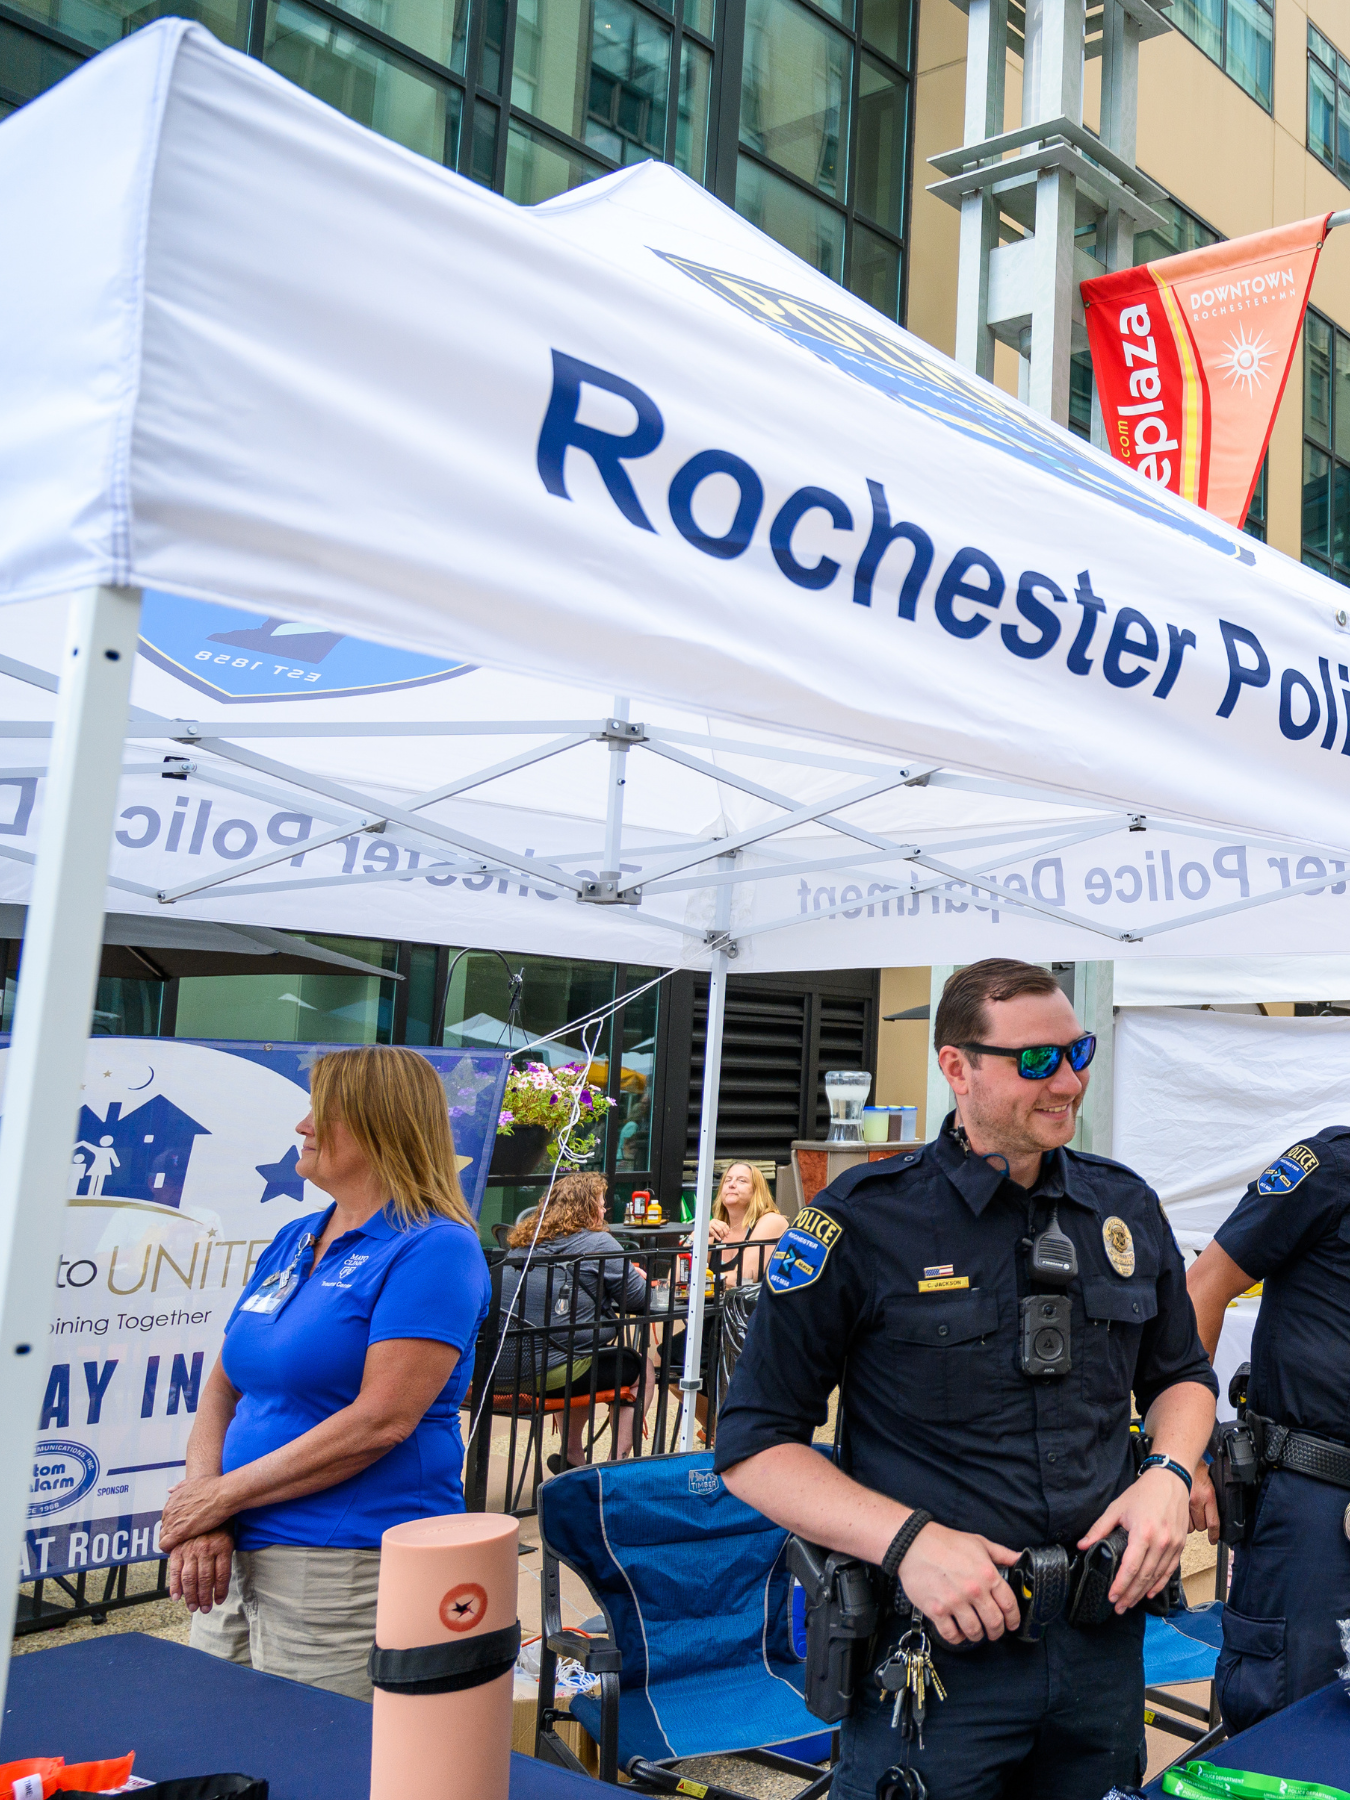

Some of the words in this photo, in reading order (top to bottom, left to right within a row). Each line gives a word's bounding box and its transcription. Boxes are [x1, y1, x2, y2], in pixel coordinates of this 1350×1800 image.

[1190, 268, 1295, 310] DOWNTOWN
[536, 347, 1196, 700] Rochester
[56, 1254, 98, 1288] to
[934, 1279, 962, 1288] JACKSON
[117, 1309, 213, 1332] Together
[140, 1351, 205, 1418] IN
[97, 1484, 129, 1497] SPONSOR
[690, 1480, 716, 1490] TIMBER
